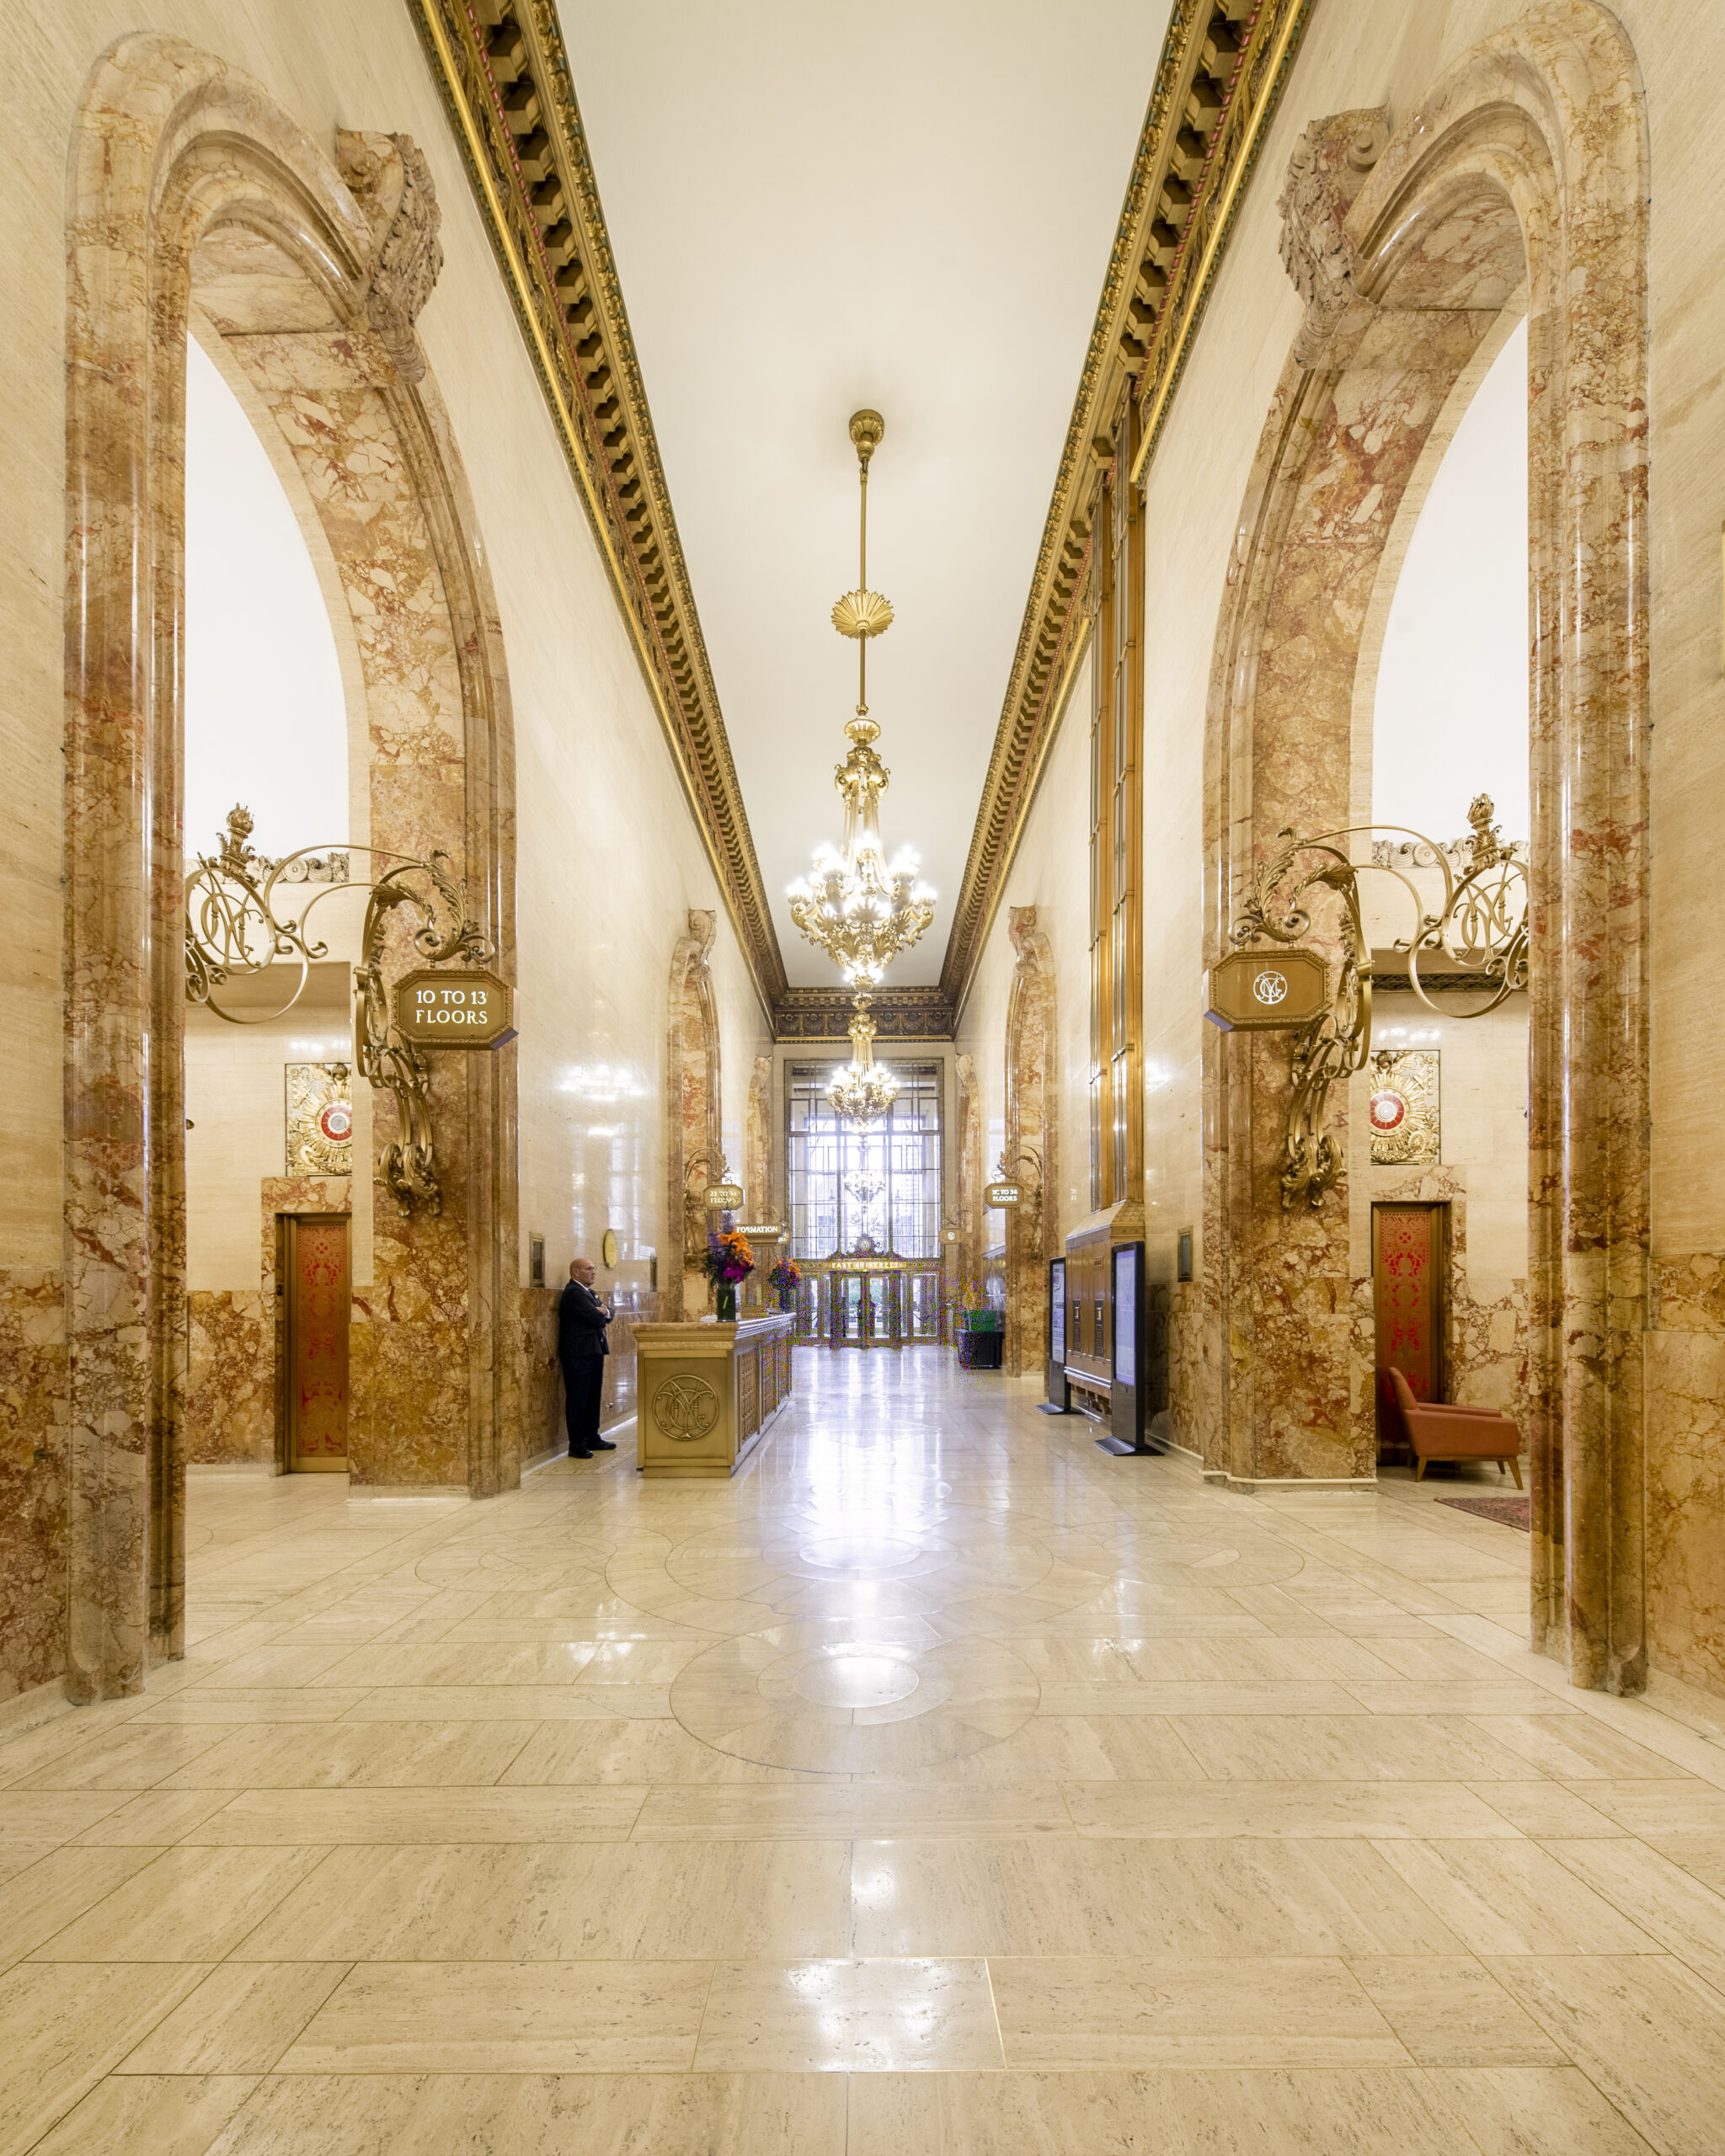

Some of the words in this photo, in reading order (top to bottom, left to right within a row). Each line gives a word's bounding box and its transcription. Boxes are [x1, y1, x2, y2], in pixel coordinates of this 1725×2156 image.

[416, 990, 435, 1004] 10
[441, 990, 466, 1004] TO
[470, 990, 487, 1005] 13
[415, 1010, 488, 1024] FLOORS
